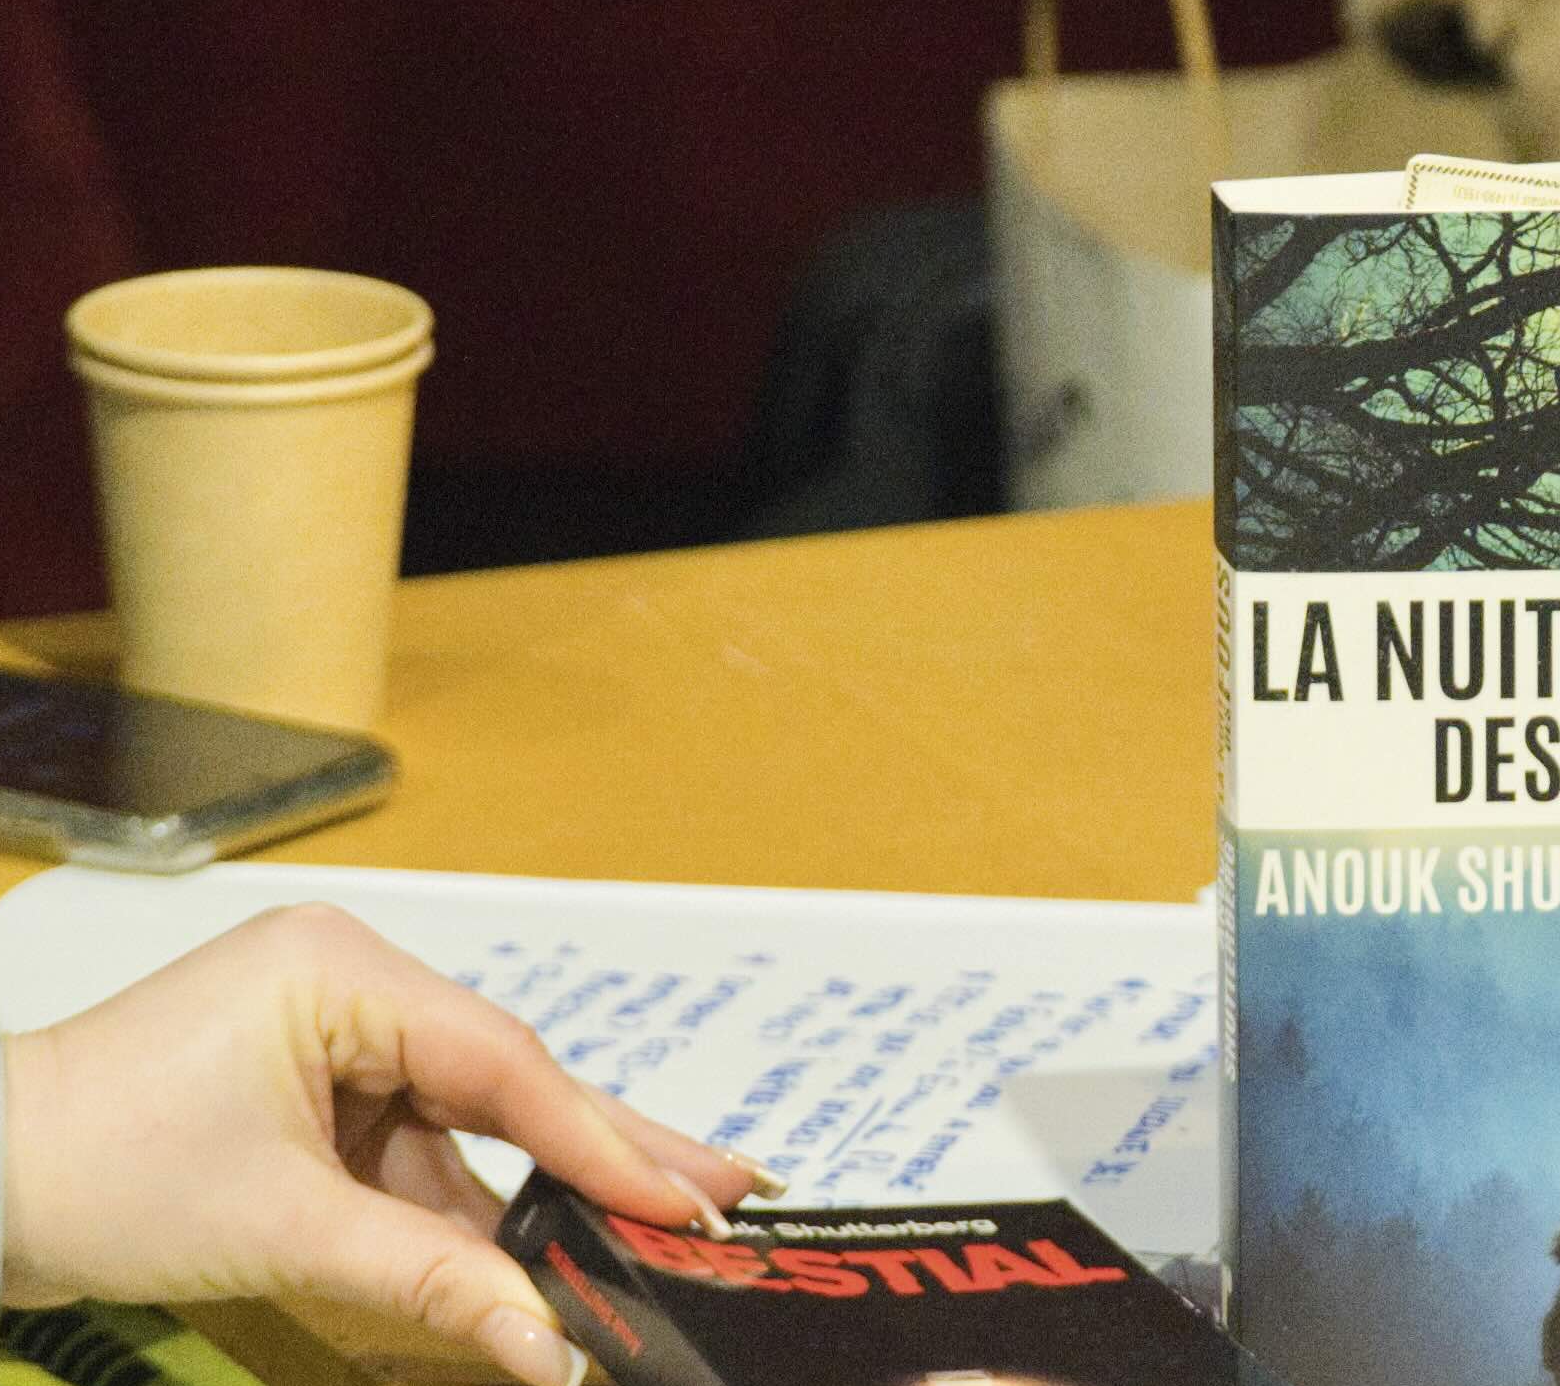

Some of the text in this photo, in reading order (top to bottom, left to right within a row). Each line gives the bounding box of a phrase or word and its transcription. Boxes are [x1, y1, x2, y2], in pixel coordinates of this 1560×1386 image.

[1252, 600, 1343, 701] LA
[1435, 716, 1560, 803] DES
[1255, 846, 1442, 916] ANOUK
[608, 1215, 1126, 1298] BESTIAL
